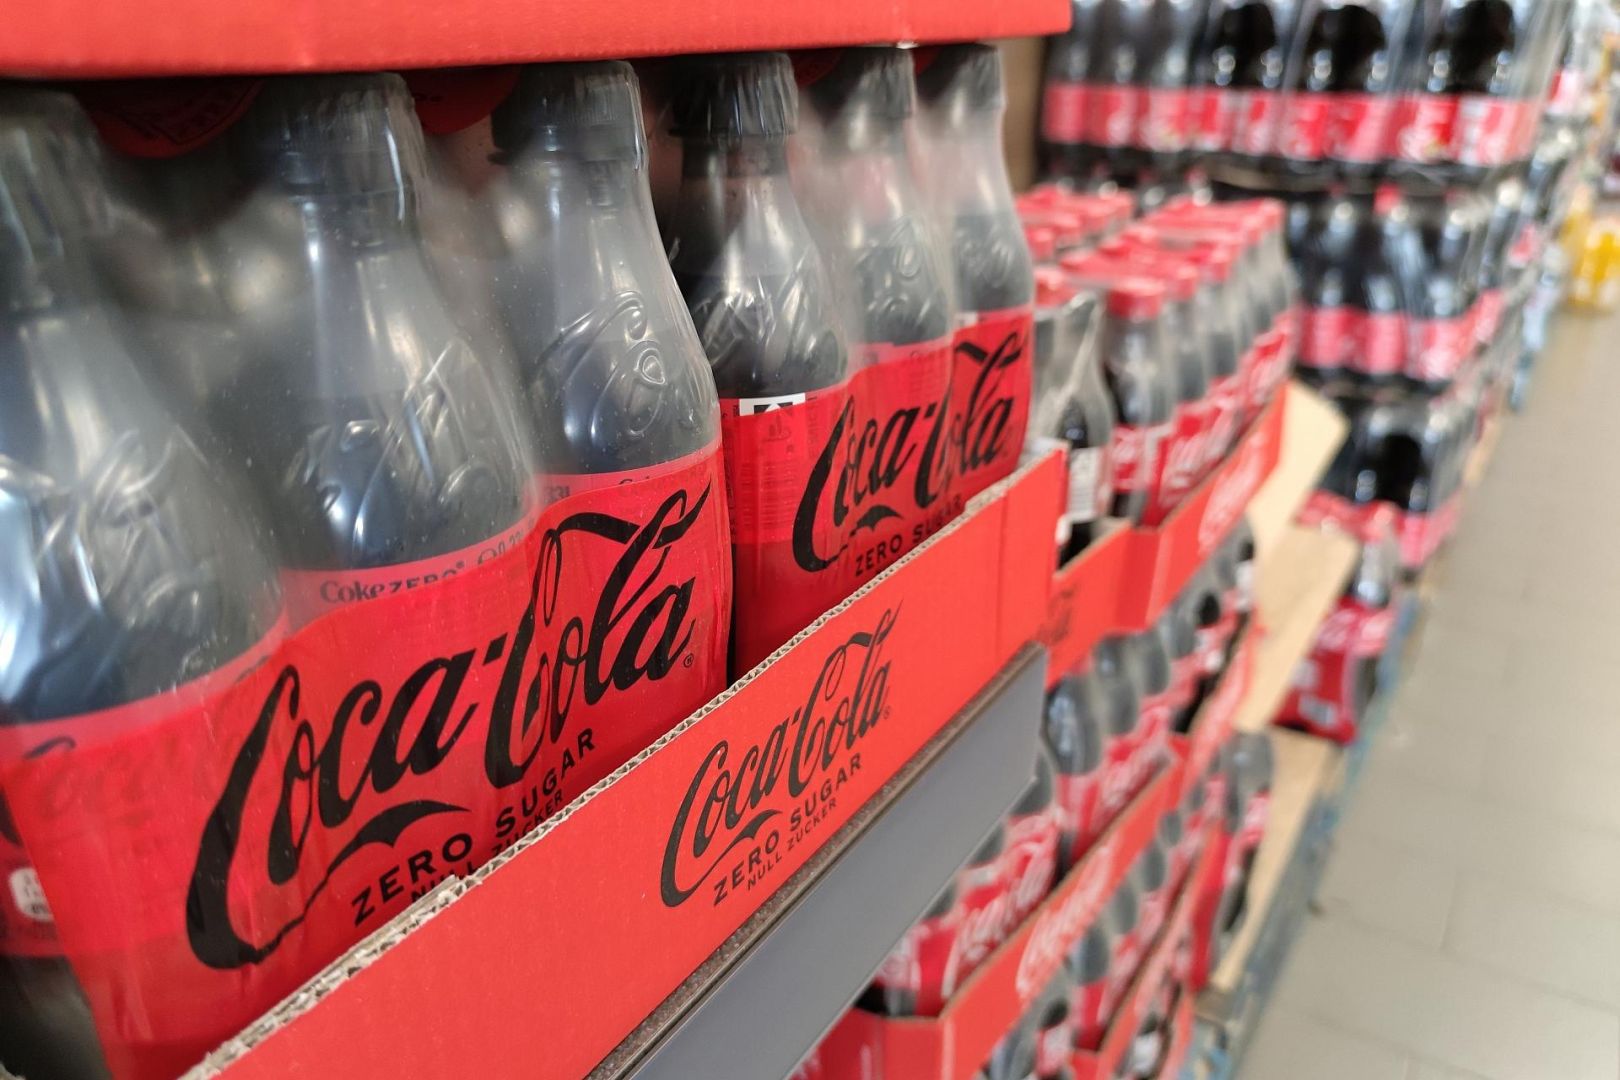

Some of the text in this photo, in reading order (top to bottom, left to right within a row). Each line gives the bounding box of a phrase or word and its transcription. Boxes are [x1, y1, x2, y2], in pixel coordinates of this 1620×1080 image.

[854, 532, 903, 578] ZERO
[185, 476, 712, 972] Coca-Cola
[660, 598, 905, 908] Coca-Cola
[351, 727, 596, 927] ZERO SUGAR
[712, 751, 862, 907] ZERO SUGAR
[745, 798, 838, 892] NULL ZUCKER
